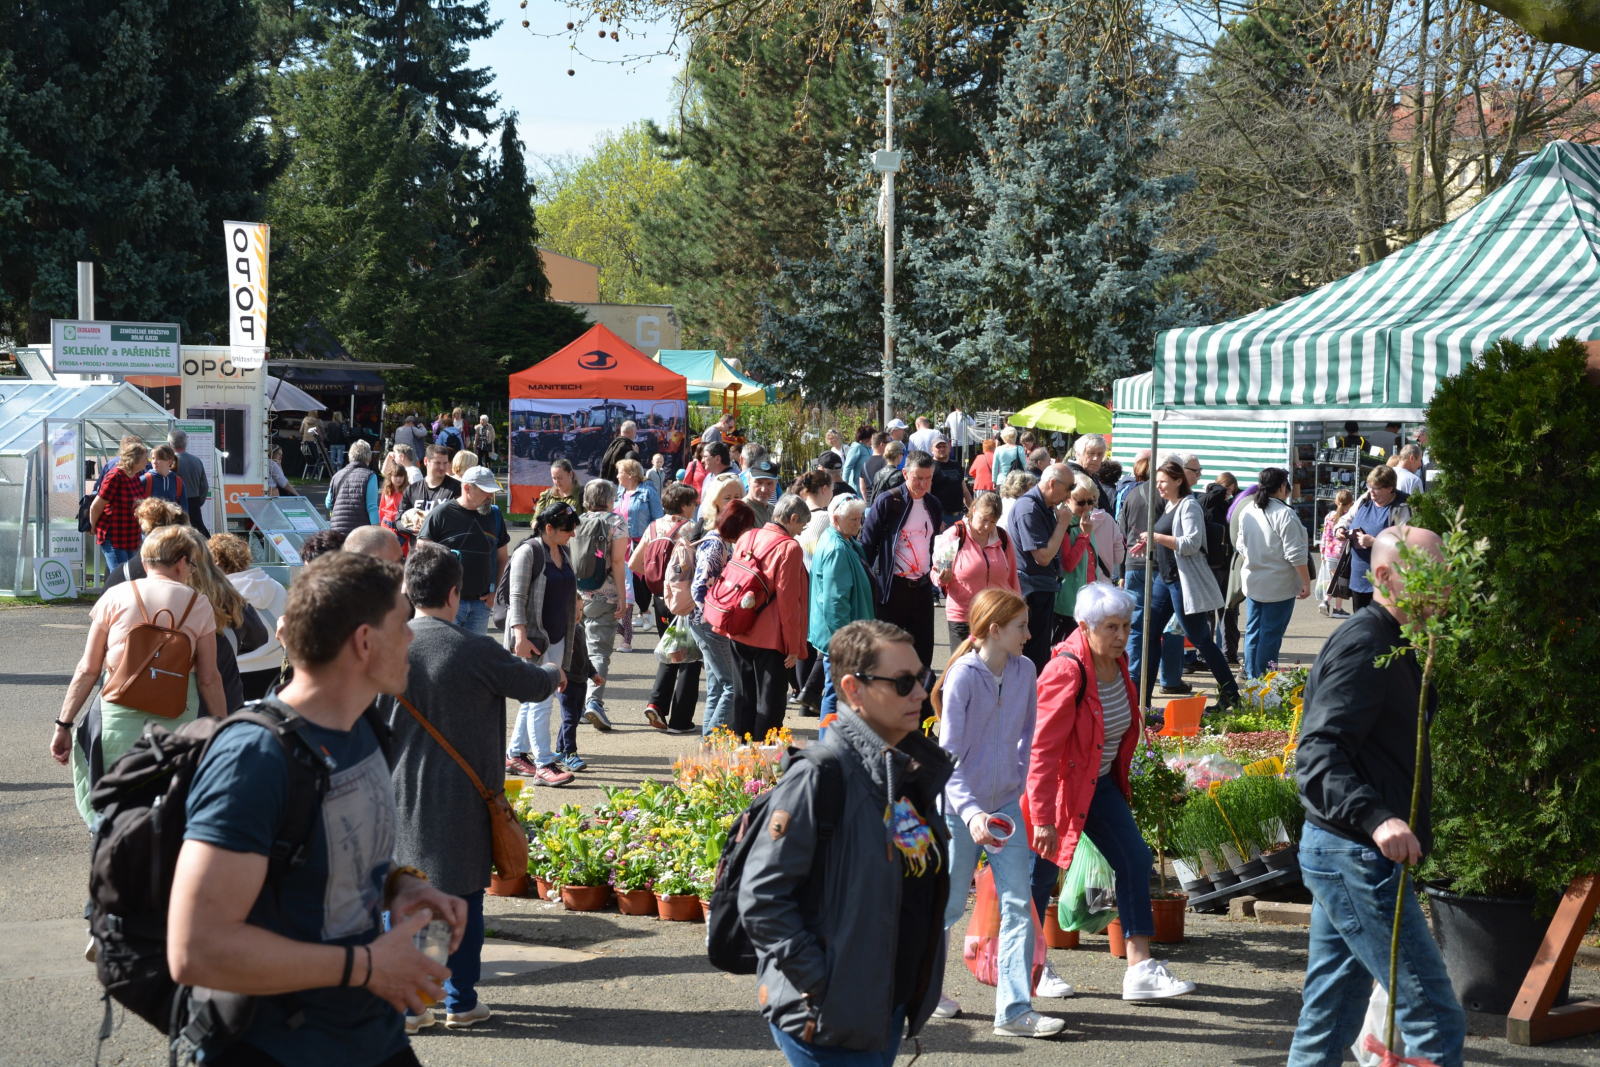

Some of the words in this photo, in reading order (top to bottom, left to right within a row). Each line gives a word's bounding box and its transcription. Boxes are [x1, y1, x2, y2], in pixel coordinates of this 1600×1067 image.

[636, 315, 660, 347] G
[62, 344, 109, 356] SKLENÍKY
[121, 345, 171, 358] PAŘENIŠTĚ
[45, 568, 62, 580] ČESKÝ
[47, 578, 66, 587] VÝROBEK
